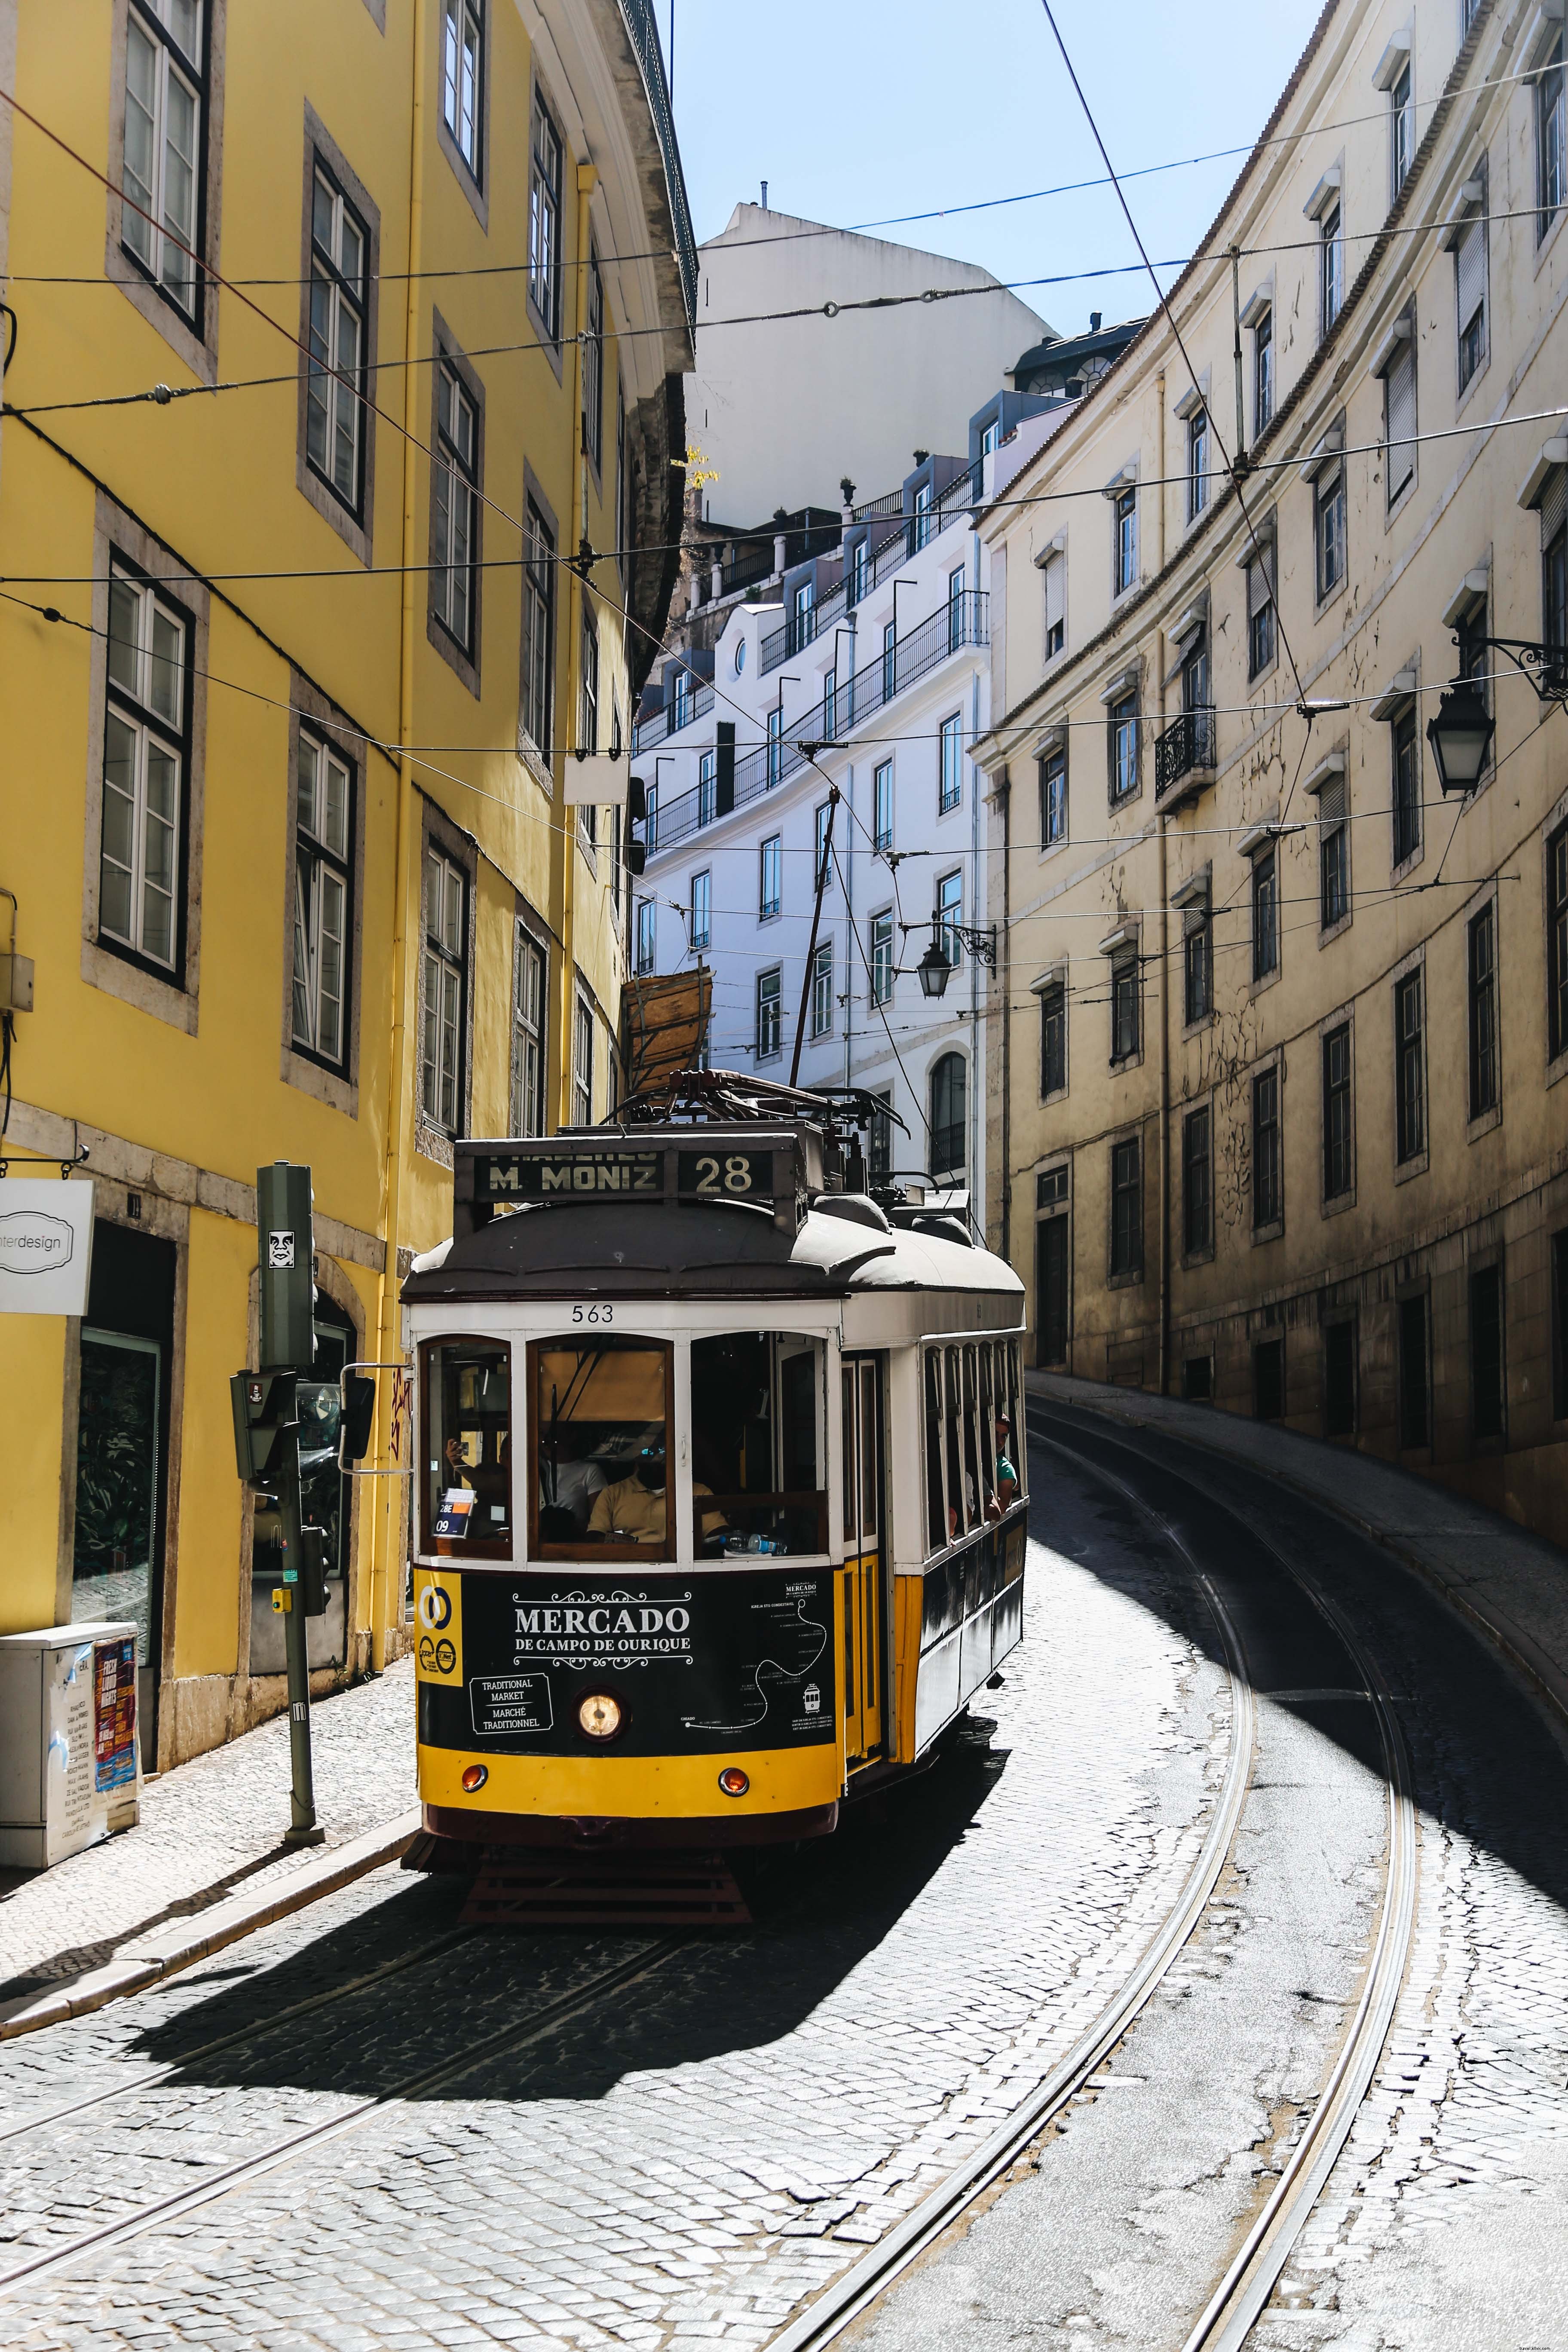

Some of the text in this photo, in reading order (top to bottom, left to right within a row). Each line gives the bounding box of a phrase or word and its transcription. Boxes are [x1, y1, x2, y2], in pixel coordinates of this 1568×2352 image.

[490, 1166, 656, 1190] M. MONIZ
[695, 1156, 752, 1193] 28
[572, 1305, 613, 1323] 563
[440, 1504, 453, 1513] 28E
[436, 1520, 449, 1532] 09
[515, 1607, 690, 1634] MERCADO
[515, 1638, 691, 1652] DE CAMPO DE OURIQUE
[482, 1679, 533, 1690] TRADITIONAL
[492, 1691, 524, 1701] MARKET
[493, 1706, 526, 1718] MARCHÉ
[483, 1718, 540, 1730] TRADITIONNEL
